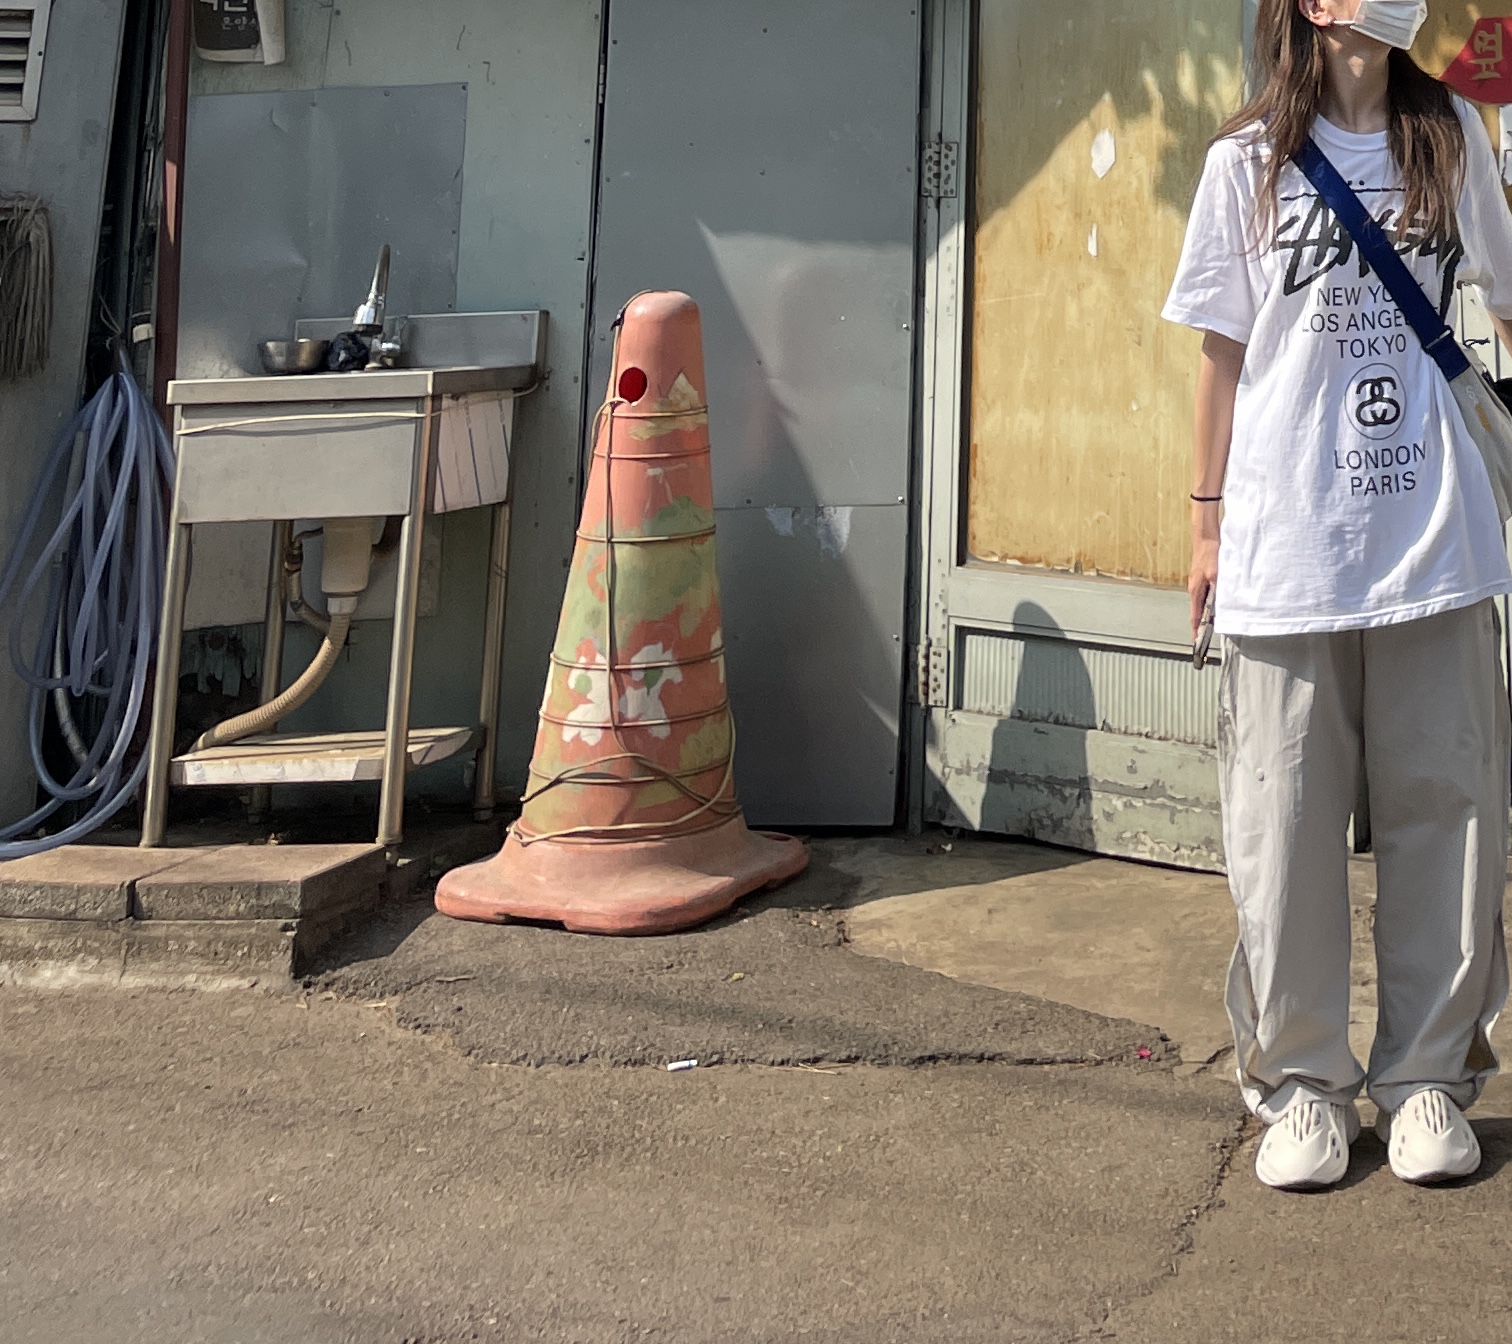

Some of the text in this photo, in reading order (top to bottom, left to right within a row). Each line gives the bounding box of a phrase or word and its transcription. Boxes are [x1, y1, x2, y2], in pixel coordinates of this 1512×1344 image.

[1316, 286, 1361, 306] NEW
[1336, 334, 1407, 359] TOKYO
[1333, 441, 1426, 470] LONDON
[1350, 471, 1416, 496] PARIS
